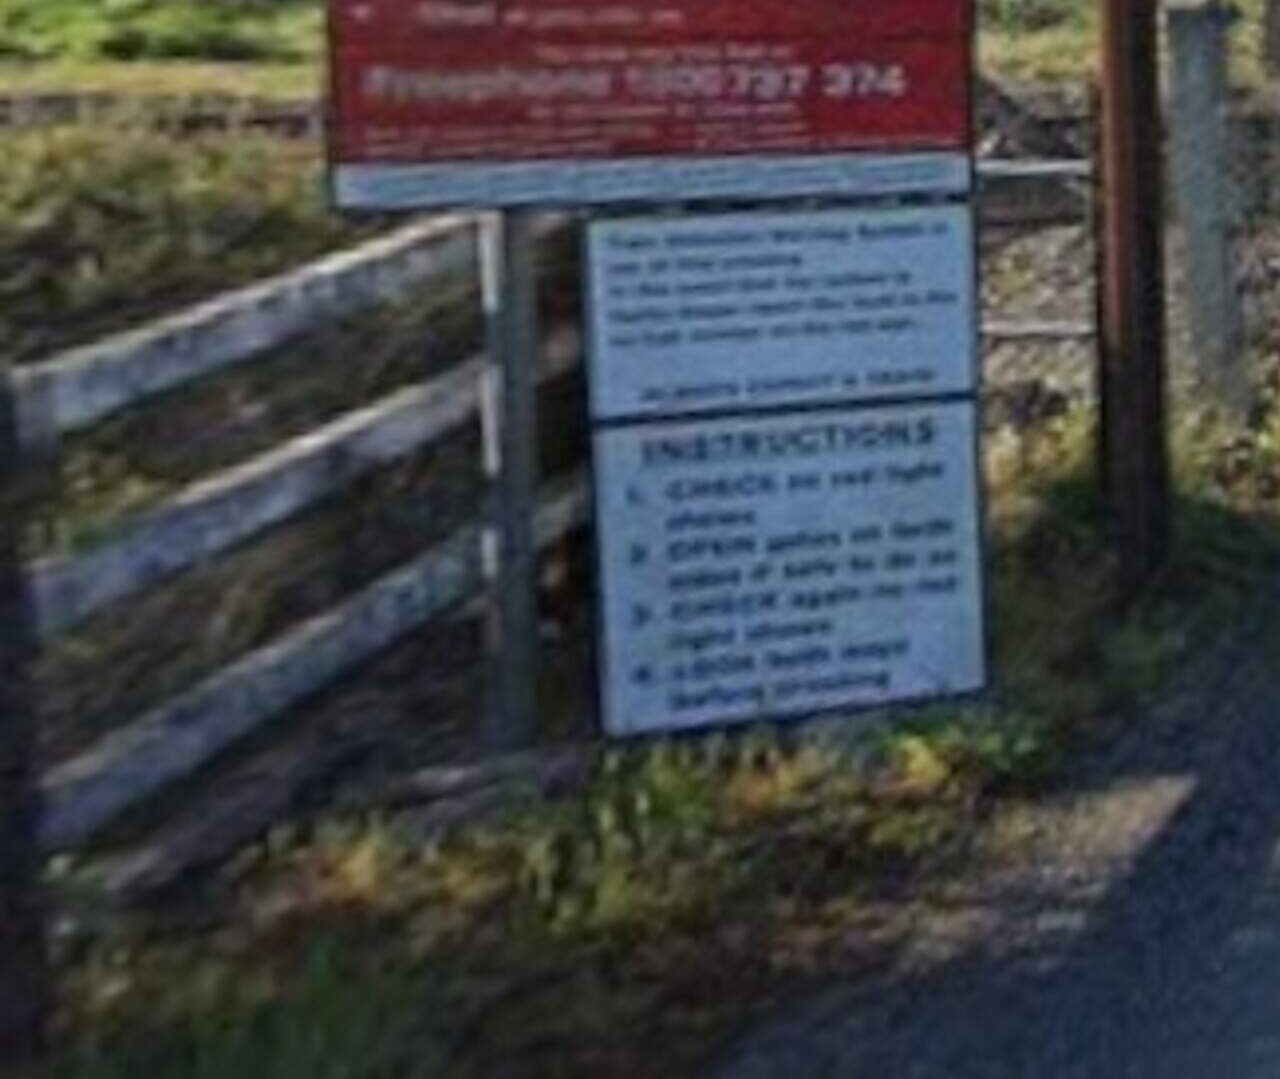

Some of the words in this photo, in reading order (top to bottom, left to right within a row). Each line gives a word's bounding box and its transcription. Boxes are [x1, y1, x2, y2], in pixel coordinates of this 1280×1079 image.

[819, 62, 908, 97] 374
[642, 417, 936, 466] INSTRUCTIONS
[665, 473, 777, 502] CHECK
